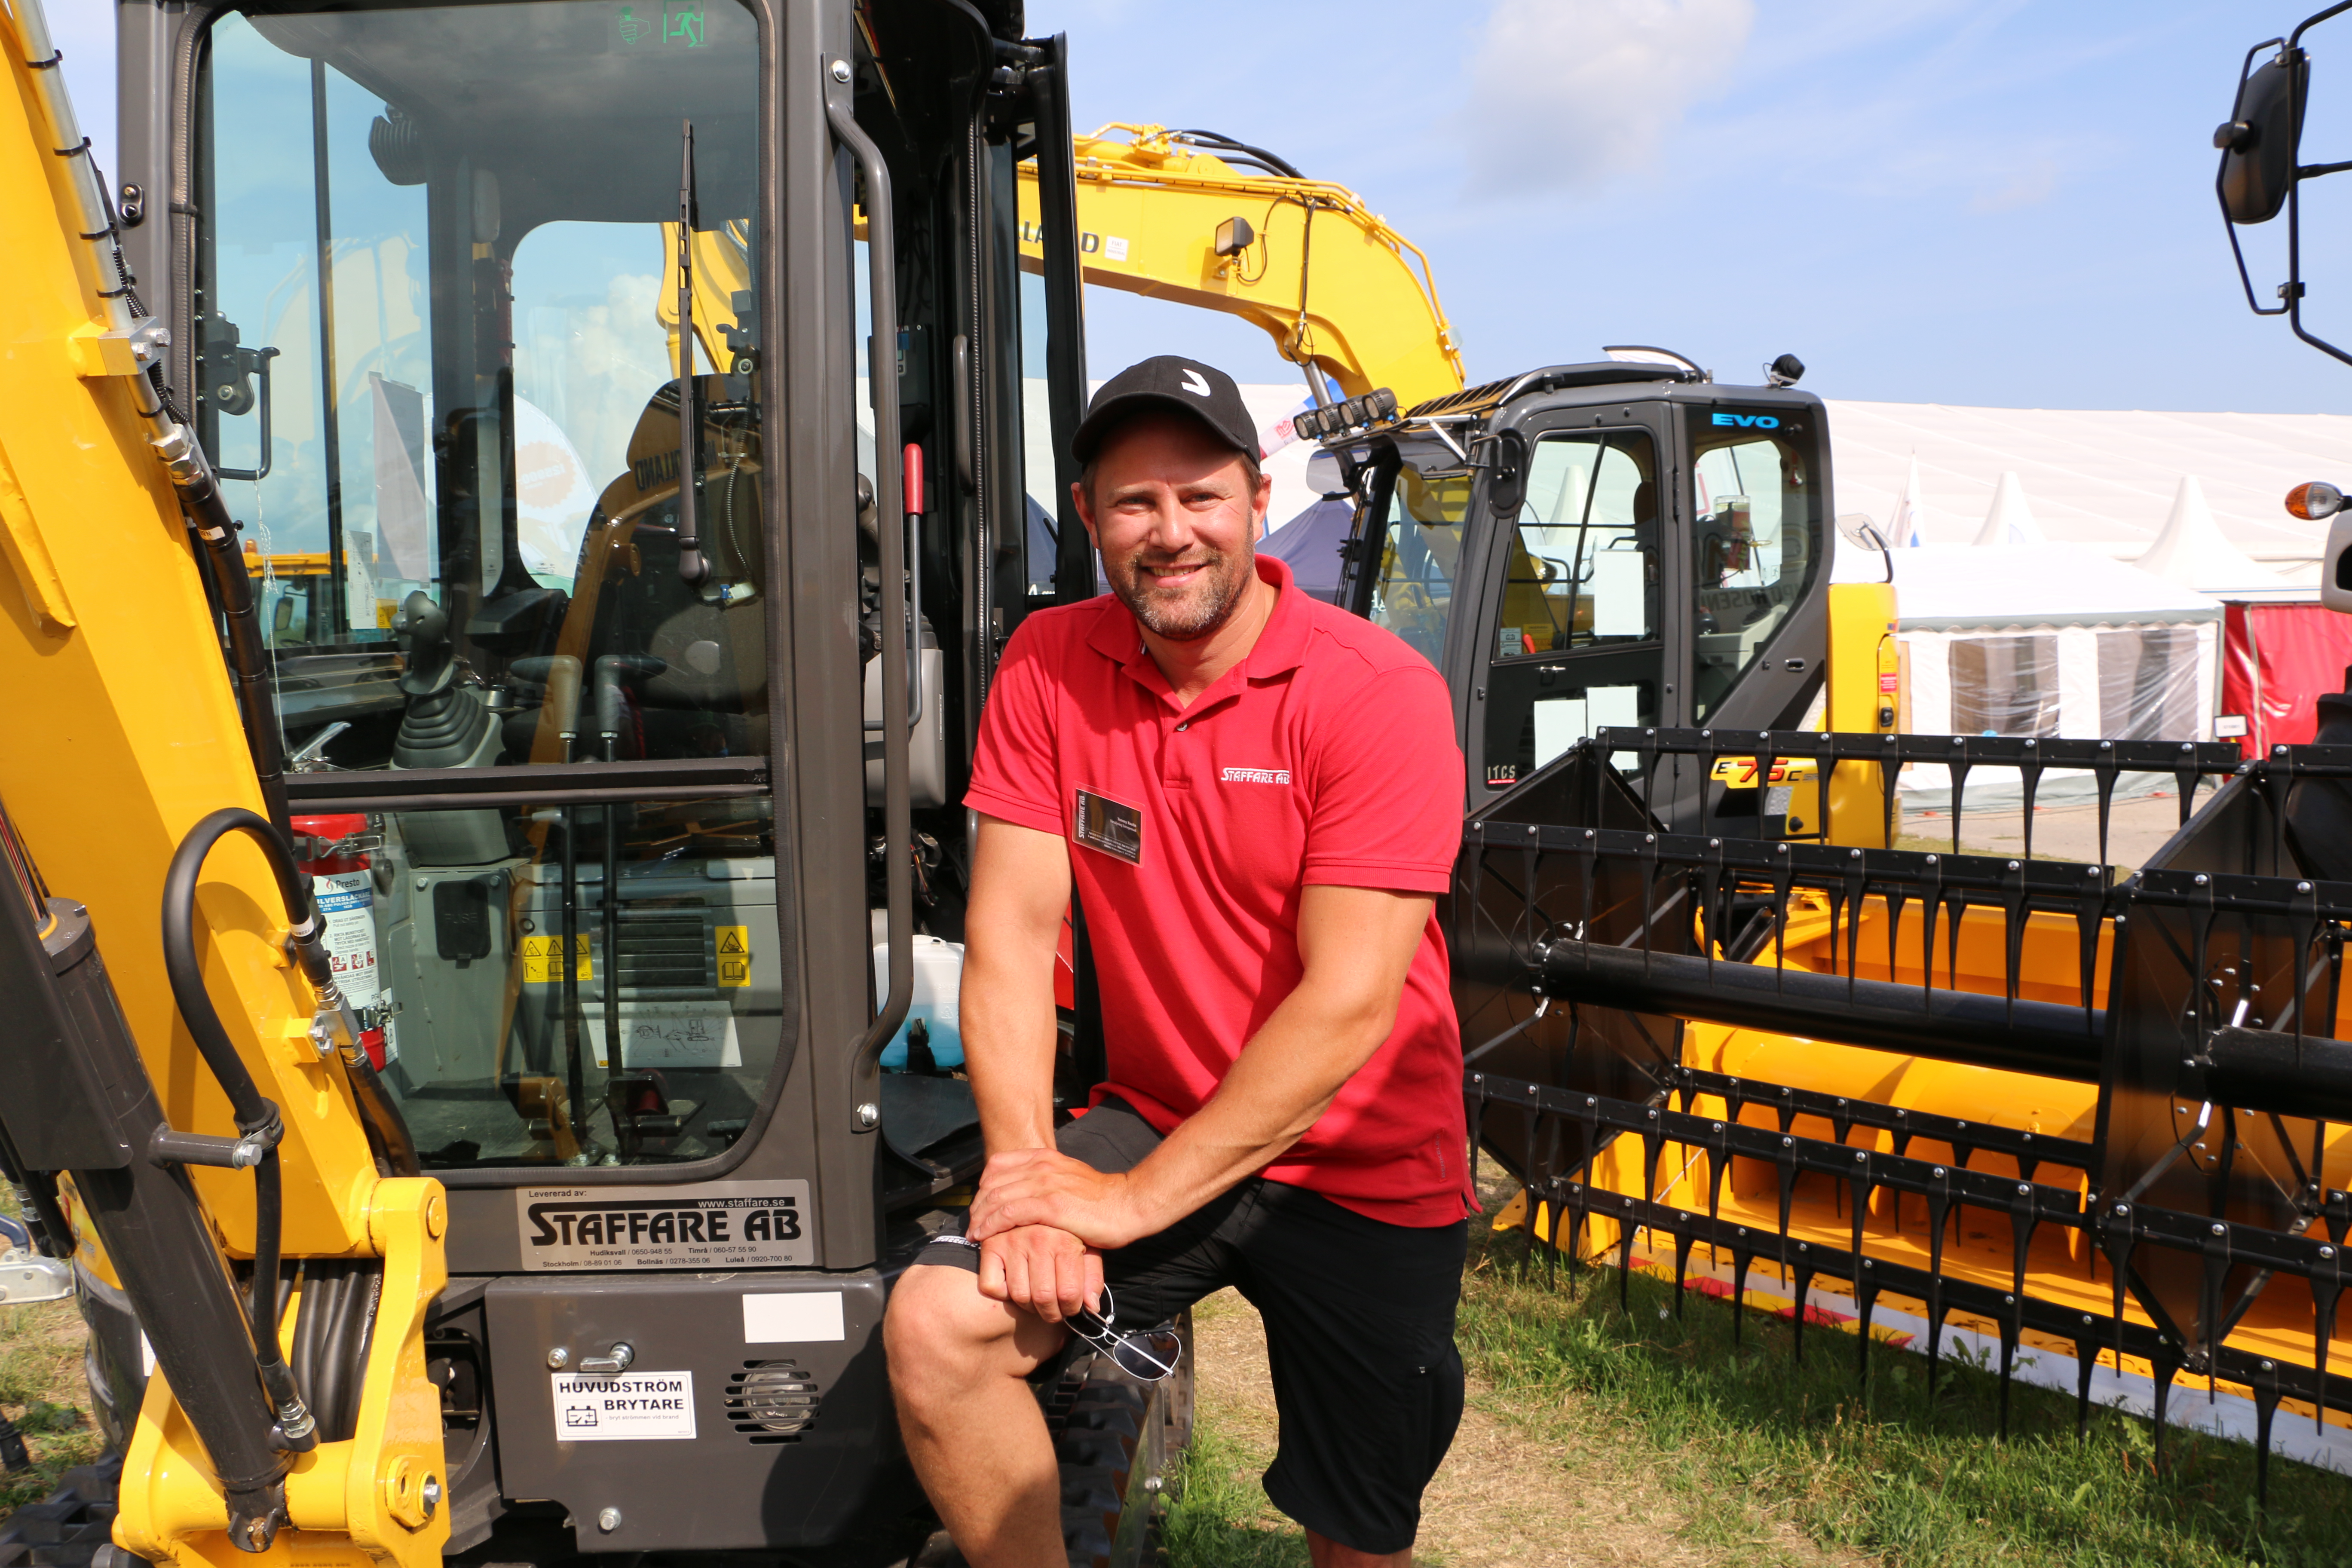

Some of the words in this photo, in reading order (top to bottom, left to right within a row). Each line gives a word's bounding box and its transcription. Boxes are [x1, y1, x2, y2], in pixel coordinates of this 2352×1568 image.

[1712, 413, 1779, 429] EVO
[1221, 767, 1273, 783] STAFFARE
[1275, 773, 1290, 784] AB
[1488, 765, 1515, 780] ITCS
[1081, 795, 1085, 806] AB
[336, 879, 359, 888] Presto
[698, 1197, 785, 1209] www.staffare.se
[528, 1202, 731, 1246] STAFFARE
[744, 1209, 801, 1242] AB
[559, 1378, 683, 1393] HUVUDSTRÖM
[604, 1399, 684, 1411] BRYTARE
